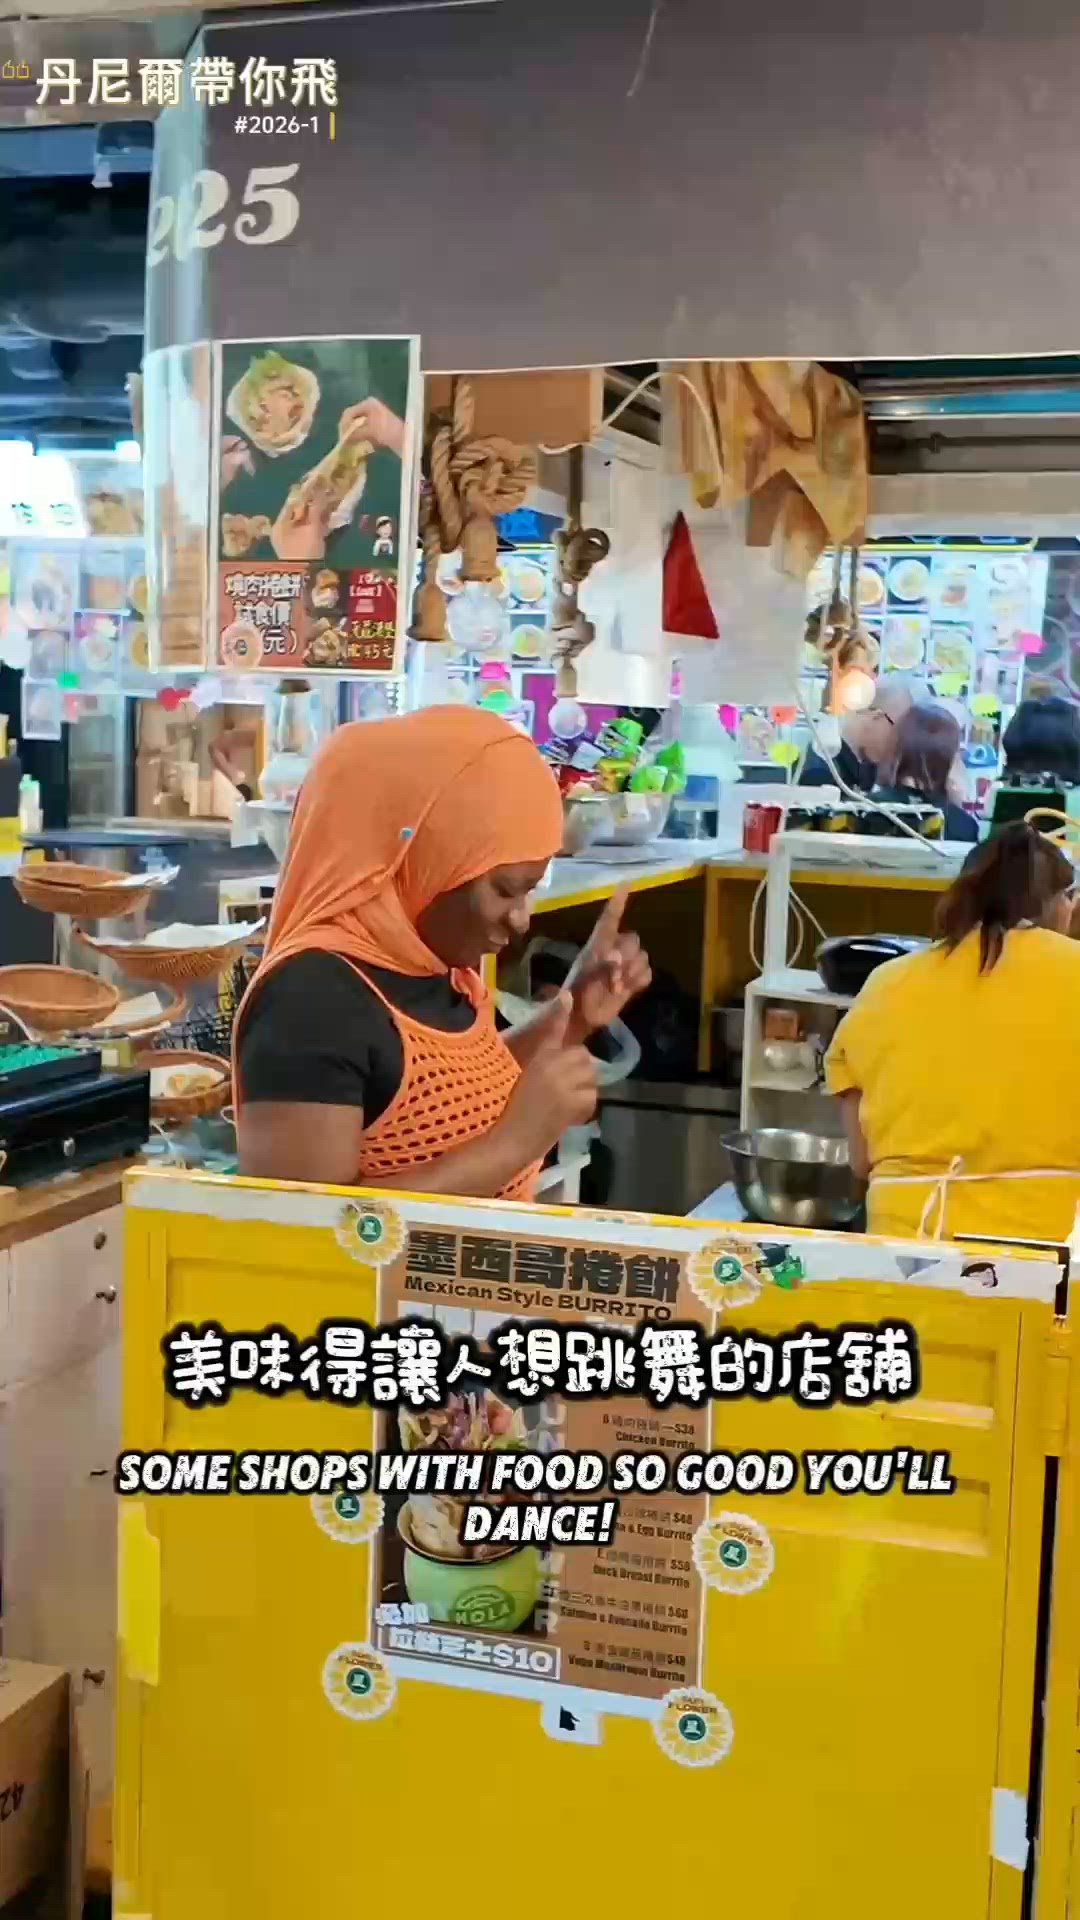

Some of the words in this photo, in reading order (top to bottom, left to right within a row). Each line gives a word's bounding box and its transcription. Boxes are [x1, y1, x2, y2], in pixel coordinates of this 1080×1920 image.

[406, 1229, 680, 1303] 墨西哥捲餅
[405, 1275, 492, 1299] Mexican
[496, 1286, 554, 1309] Style
[557, 1294, 672, 1321] BURRITO
